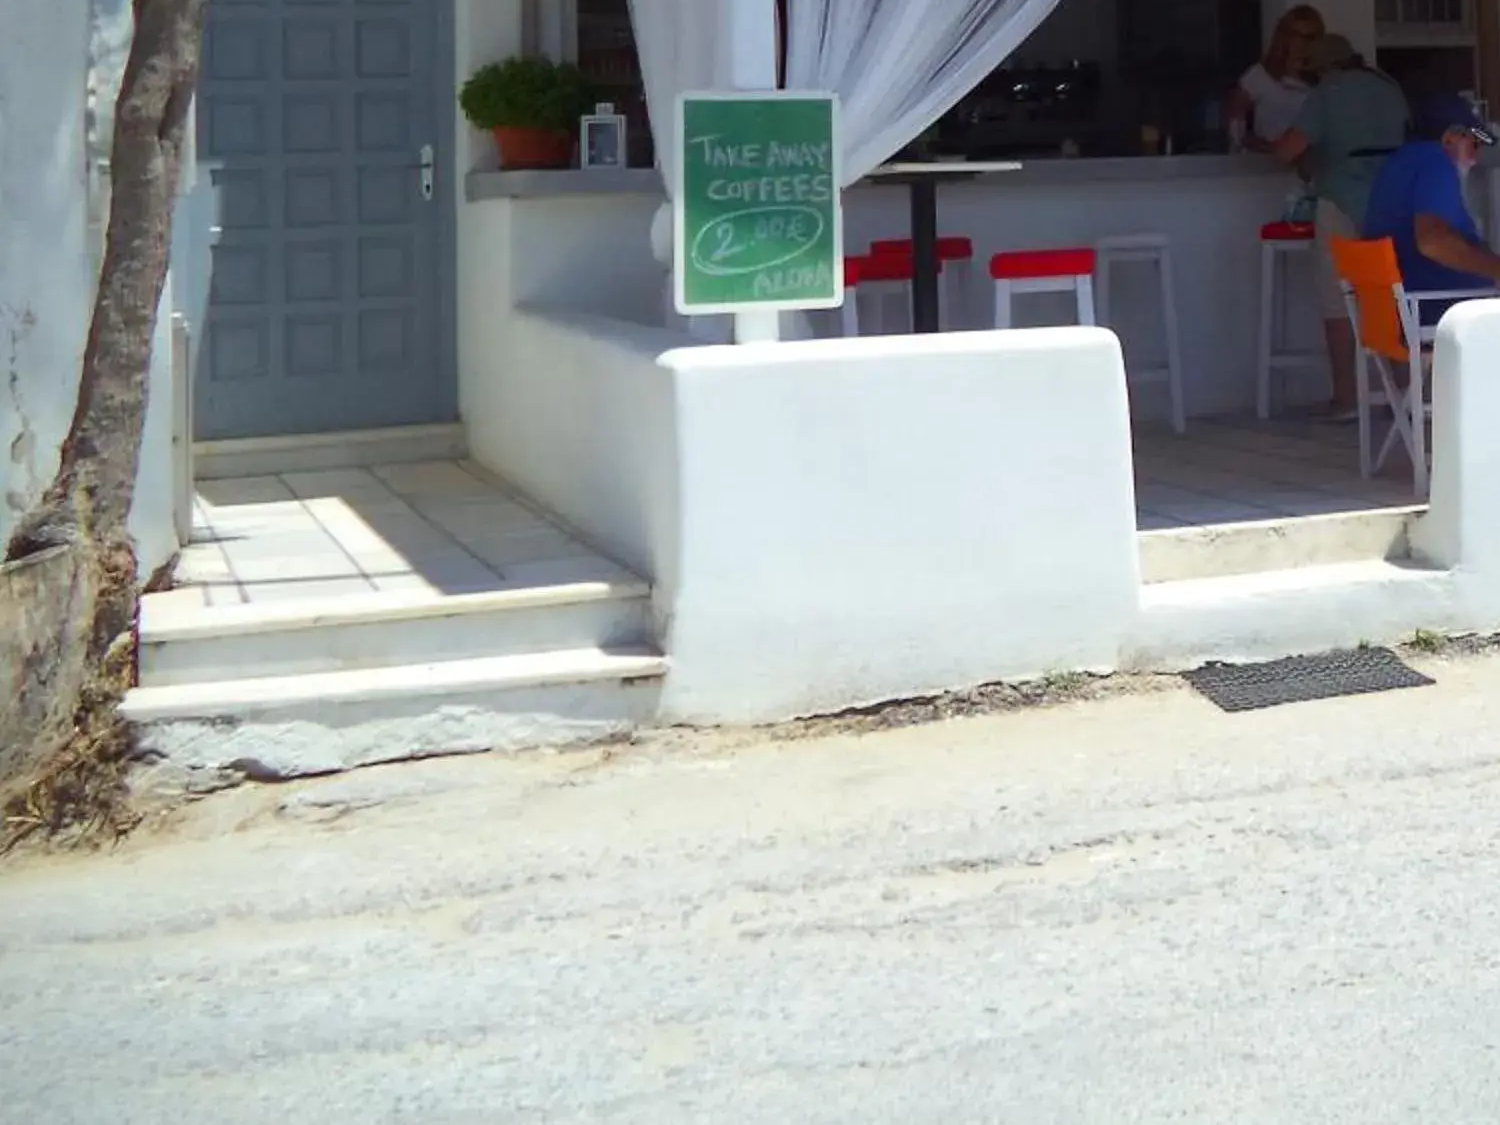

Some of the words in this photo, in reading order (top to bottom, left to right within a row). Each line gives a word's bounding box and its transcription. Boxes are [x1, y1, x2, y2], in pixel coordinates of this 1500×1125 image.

[688, 133, 762, 168] TAKE
[766, 140, 830, 171] AWAY
[707, 174, 833, 202] COFFEES
